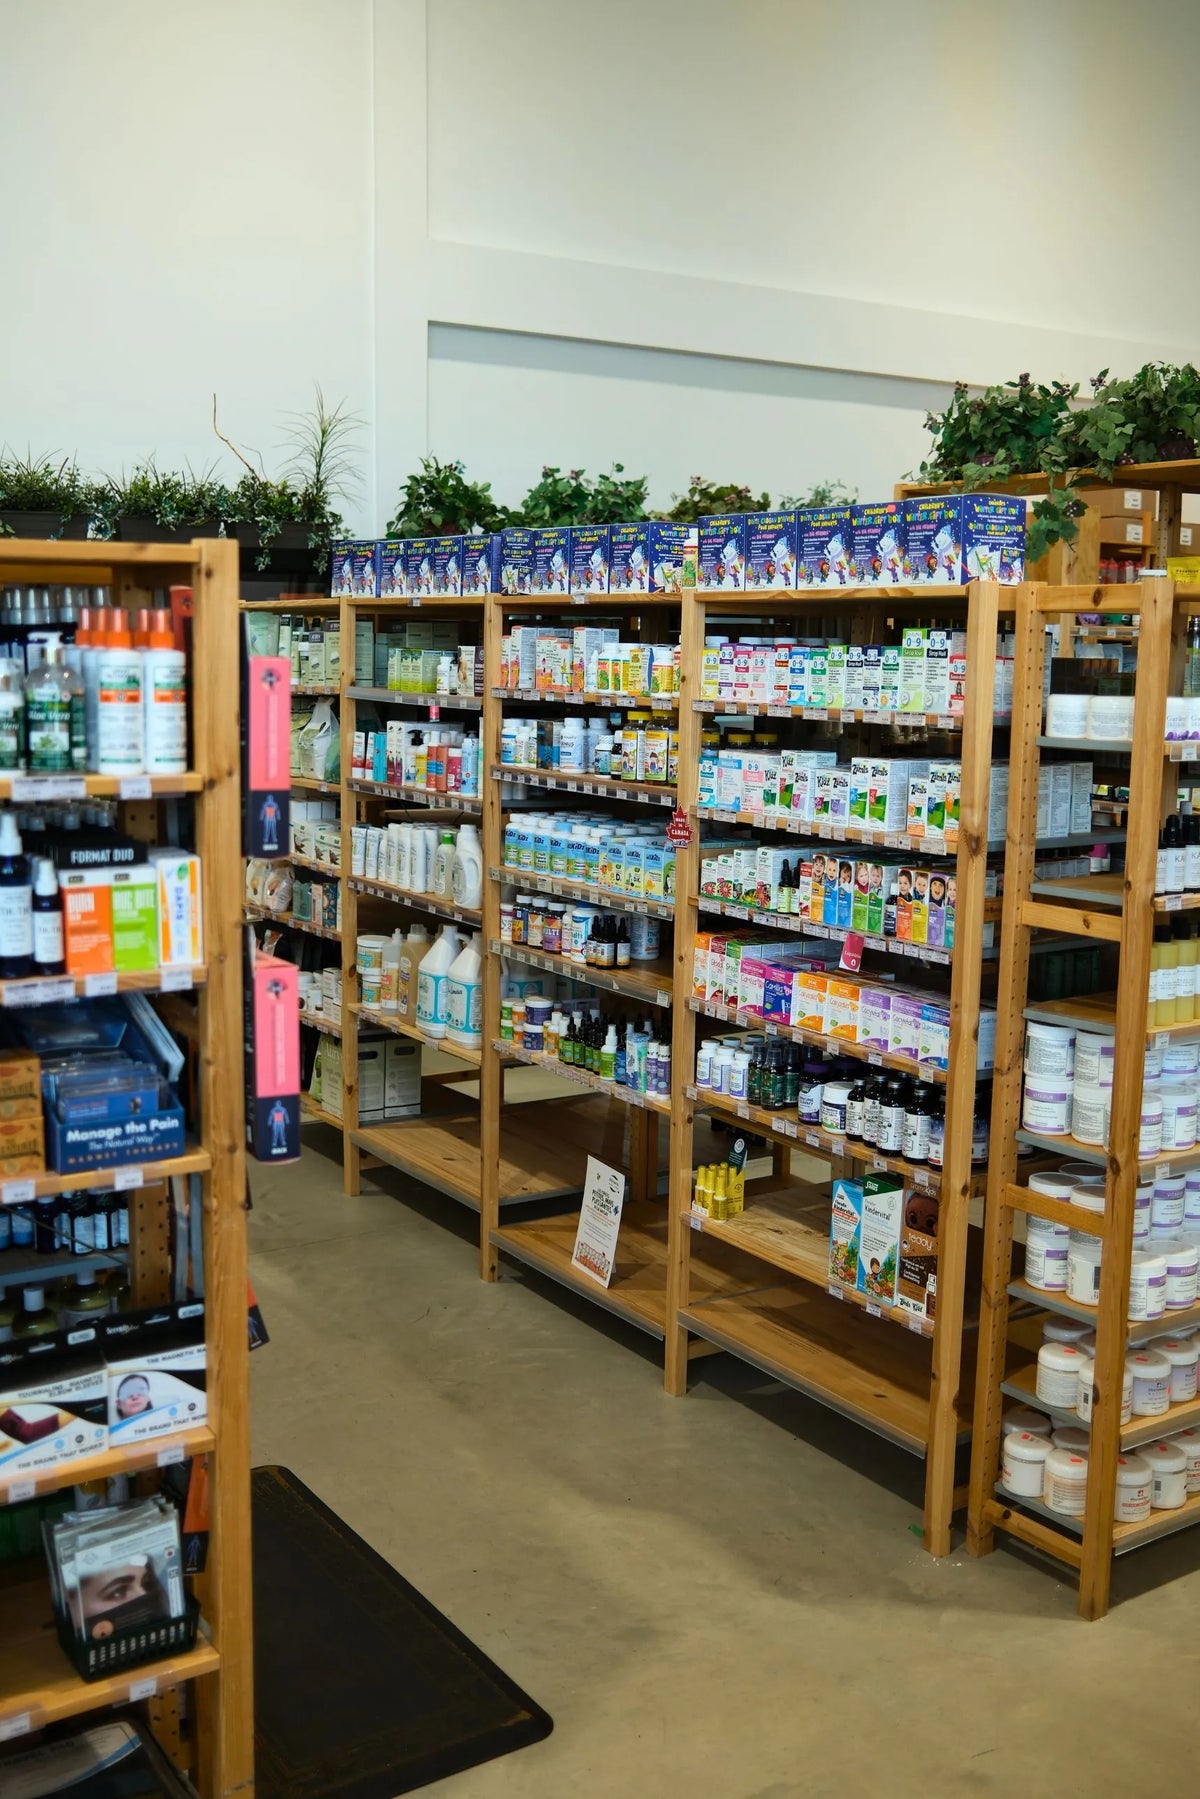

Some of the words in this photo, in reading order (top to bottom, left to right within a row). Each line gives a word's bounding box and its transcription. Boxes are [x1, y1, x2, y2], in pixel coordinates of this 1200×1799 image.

[944, 509, 958, 519] BOX
[906, 637, 921, 647] 0-9
[930, 638, 945, 647] 0-9
[721, 650, 732, 658] 0-9
[831, 652, 842, 660] 0-9
[885, 654, 897, 663] 0-9
[754, 658, 765, 666] 0-9
[792, 660, 803, 668] 0-9
[48, 712, 71, 720] Vera
[70, 849, 110, 864] FORMAT
[112, 848, 134, 861] DUO
[136, 889, 154, 908] BITE
[572, 930, 582, 939] ulti
[66, 1126, 122, 1142] Manage
[125, 1122, 146, 1134] the
[150, 1116, 179, 1131] Pain
[88, 1142, 103, 1150] The
[105, 1136, 135, 1150] Natural
[865, 1204, 890, 1220] Kindervital
[148, 1422, 171, 1431] BRAND
[33, 1455, 58, 1466] BRAND
[60, 1450, 77, 1458] THAT
